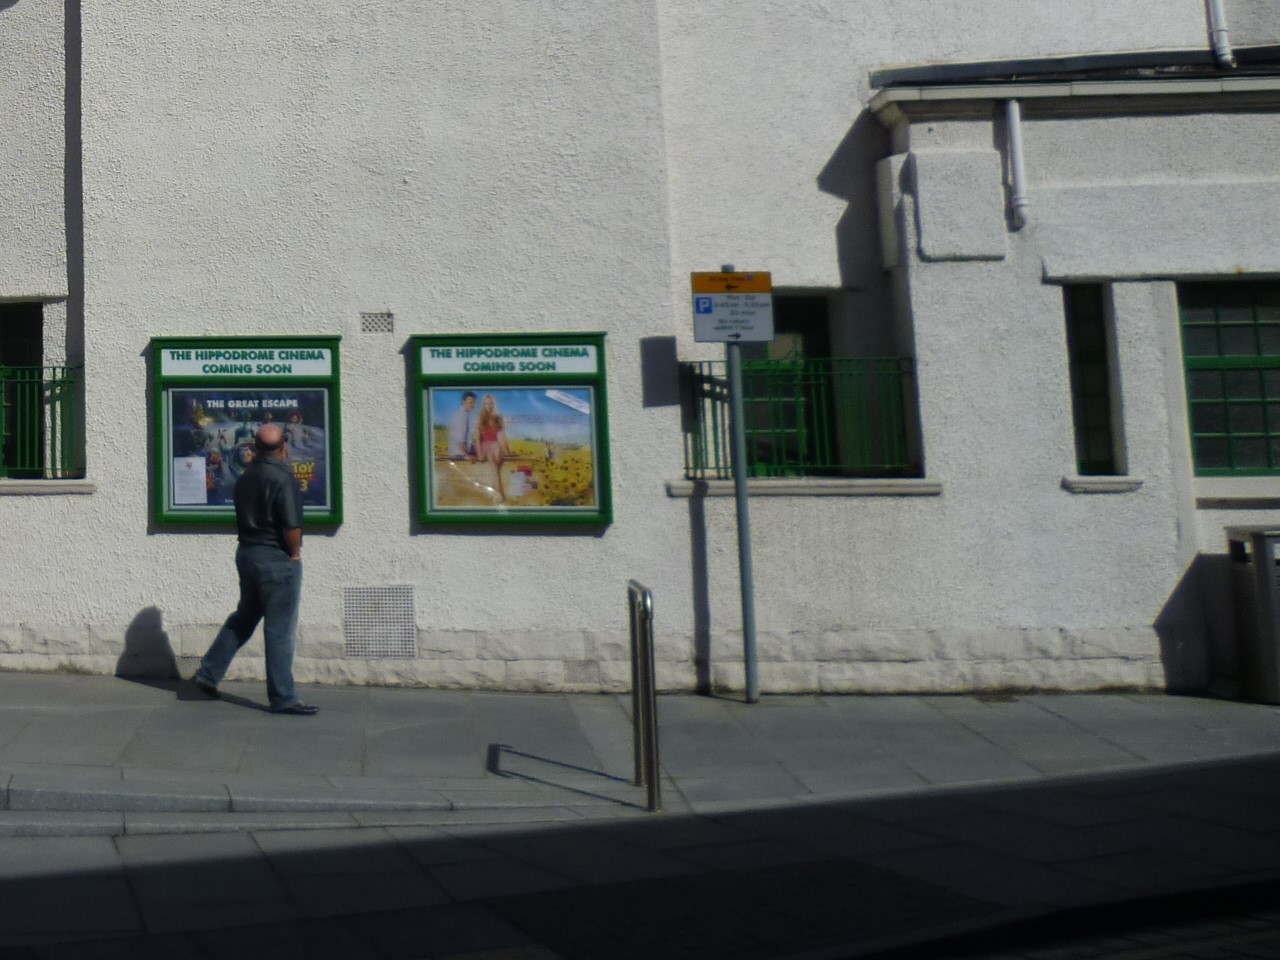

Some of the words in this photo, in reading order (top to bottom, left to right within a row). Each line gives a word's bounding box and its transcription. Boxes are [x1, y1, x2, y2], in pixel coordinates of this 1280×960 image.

[170, 350, 192, 360] THE
[195, 350, 274, 360] HIPPODROME
[278, 350, 325, 360] CINEMA
[429, 349, 452, 359] THE
[456, 348, 538, 358] HIPPODROME
[541, 348, 589, 358] CINEMA
[202, 364, 252, 374] COMING
[256, 364, 292, 373] SOON
[463, 362, 515, 372] COMING
[519, 361, 556, 371] SOON
[206, 400, 225, 408] THE
[228, 399, 260, 408] GREAT
[262, 399, 298, 408] ESCAPE
[298, 479, 309, 492] 3
